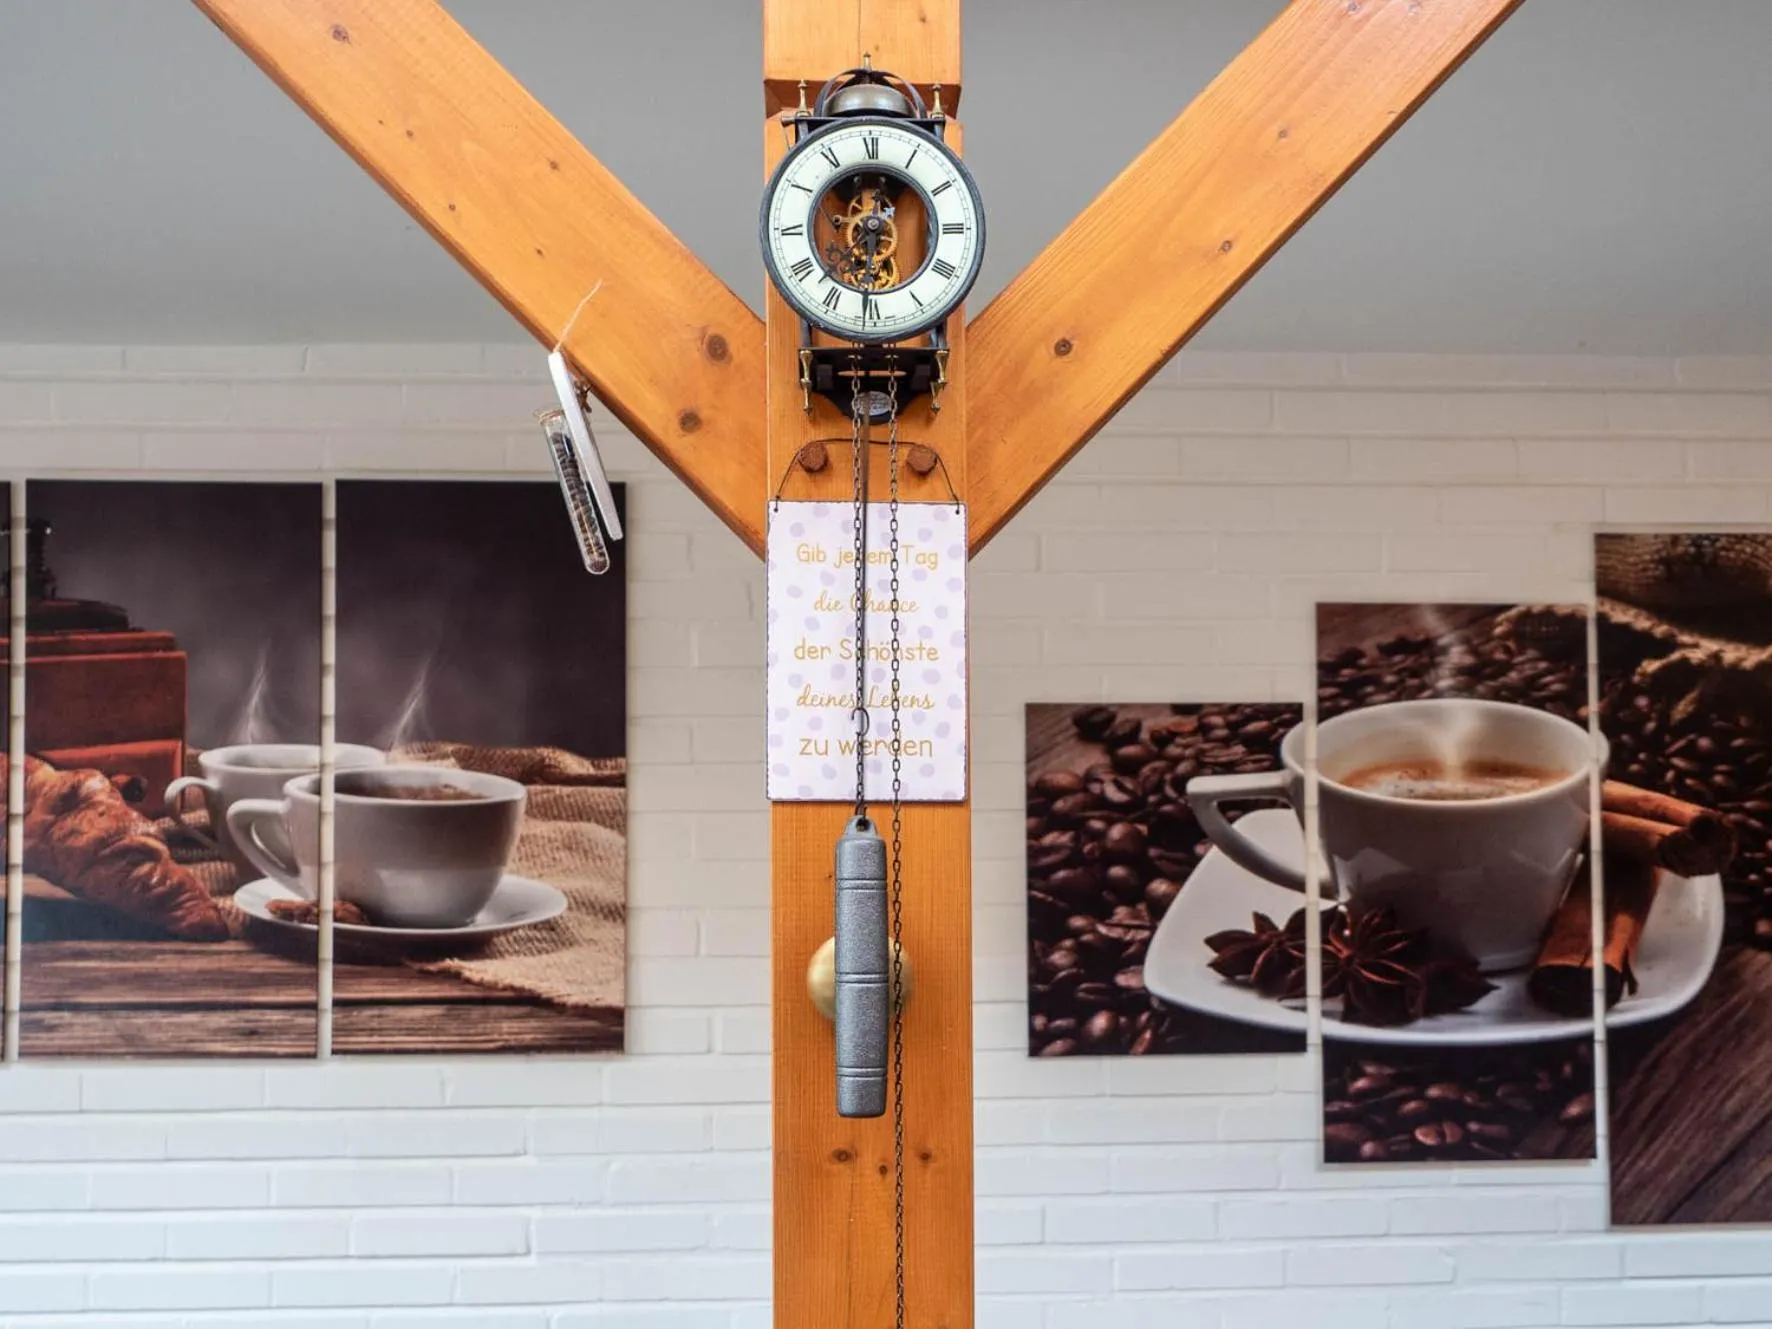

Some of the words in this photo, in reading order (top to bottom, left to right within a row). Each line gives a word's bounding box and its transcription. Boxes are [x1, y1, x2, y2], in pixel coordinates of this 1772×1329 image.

[941, 222, 965, 235] III
[796, 543, 827, 563] Gib
[834, 545, 894, 568] jeem
[901, 544, 938, 570] Tag
[814, 590, 844, 613] die
[794, 637, 831, 660] der
[839, 638, 940, 661] Shönste
[796, 683, 857, 708] deines
[866, 685, 936, 710] Leens
[799, 738, 829, 757] zu
